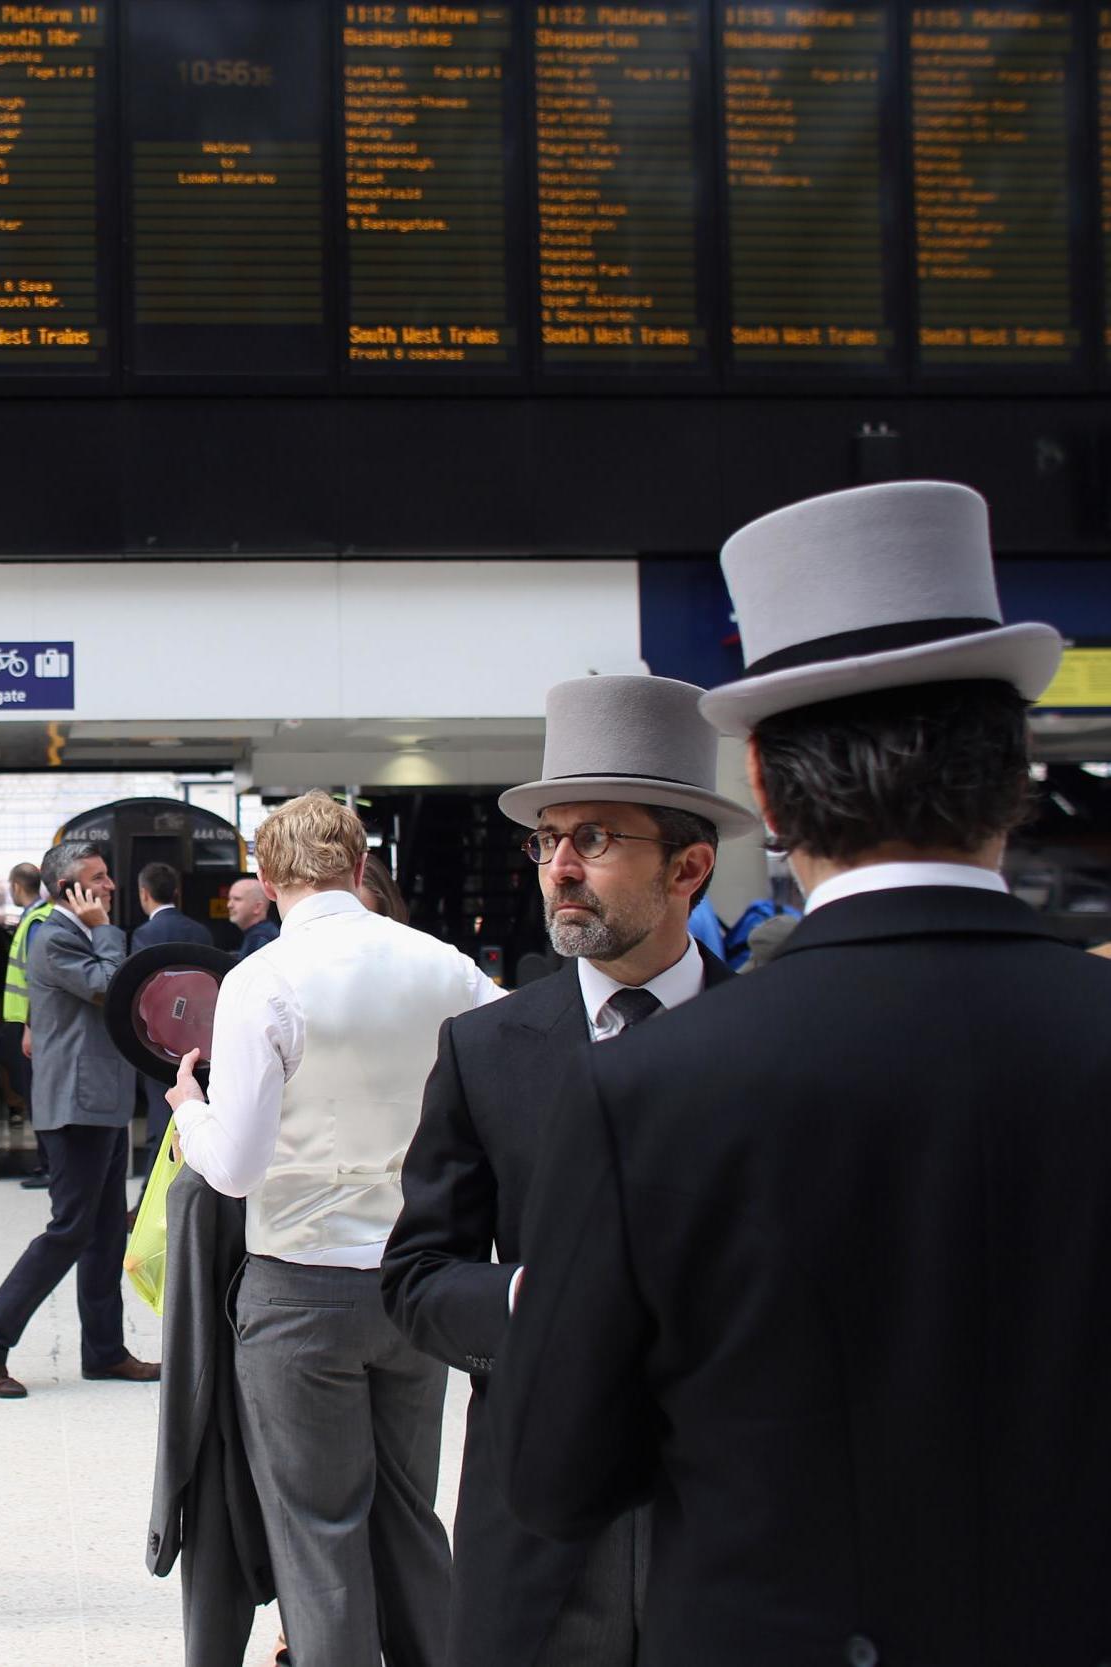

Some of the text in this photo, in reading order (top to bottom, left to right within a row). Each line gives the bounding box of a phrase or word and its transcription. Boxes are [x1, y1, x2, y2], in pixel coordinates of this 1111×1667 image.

[1, 6, 74, 24] Platform
[407, 7, 479, 24] Platform
[47, 29, 80, 45] Hbr
[343, 29, 453, 46] Basingstoke
[537, 30, 637, 48] Shepperton
[177, 59, 250, 86] 10:56
[39, 328, 90, 344] Trains
[349, 327, 499, 343] South West Trains
[542, 327, 690, 343] South West Trains
[732, 328, 877, 343] South West Trains
[348, 348, 390, 359] Front
[407, 348, 465, 359] coaches
[88, 829, 110, 841] 016
[192, 828, 236, 840] 444 016
